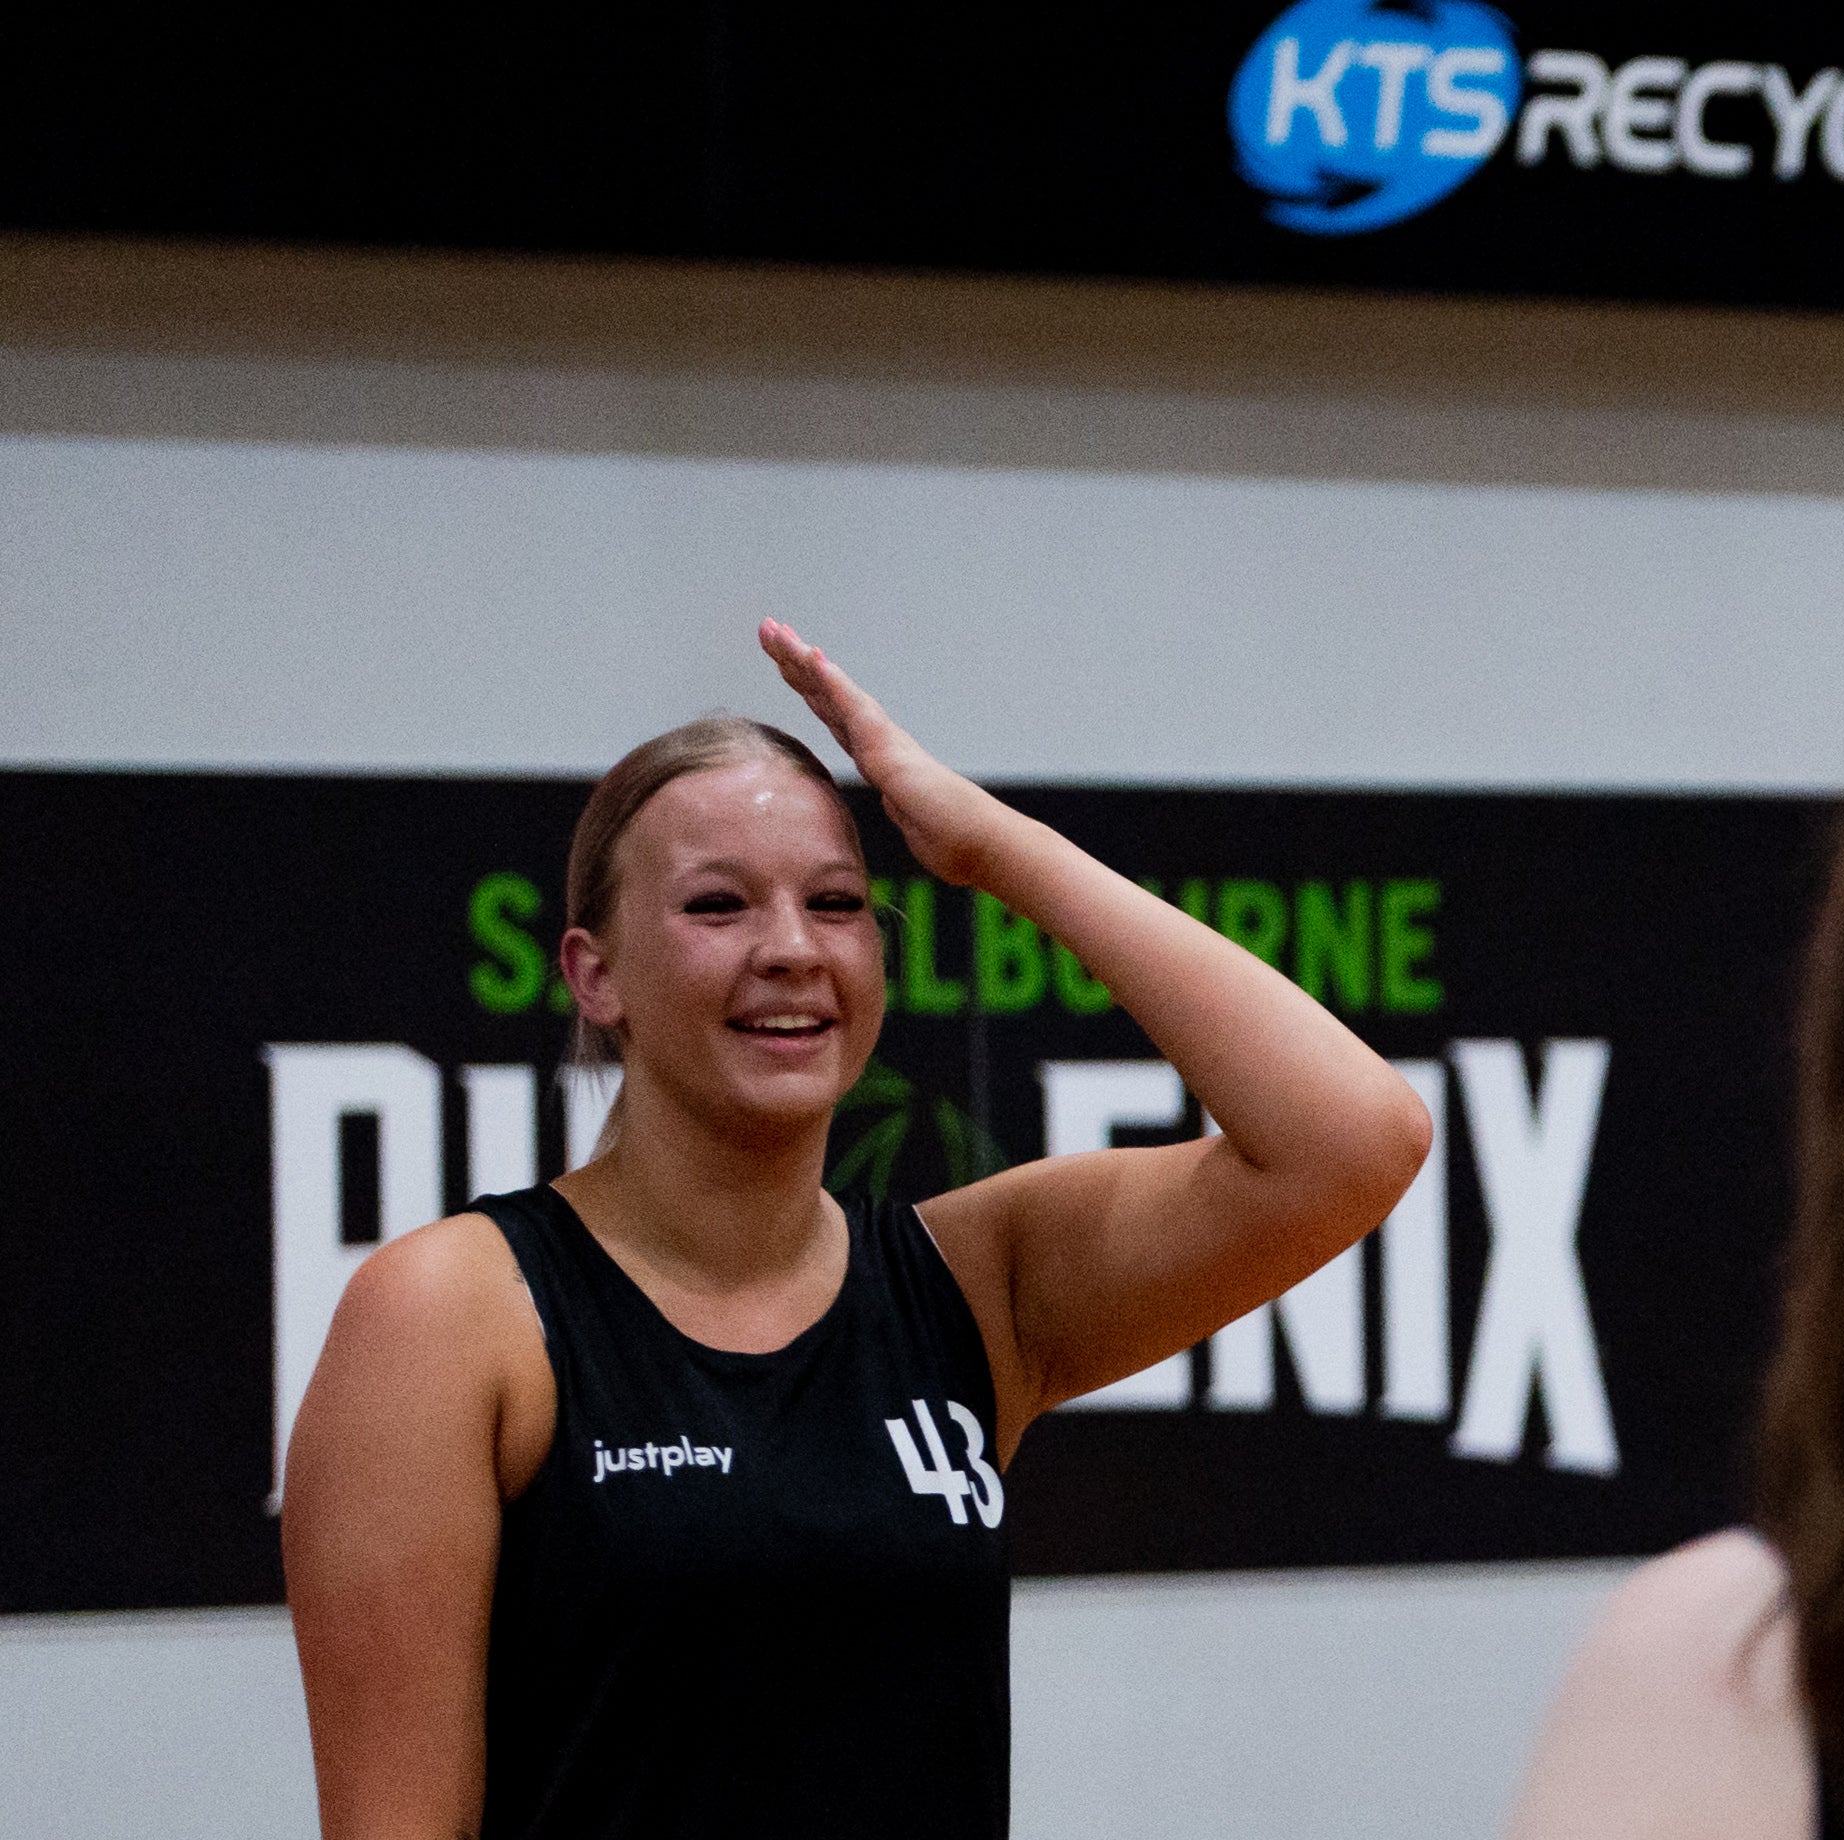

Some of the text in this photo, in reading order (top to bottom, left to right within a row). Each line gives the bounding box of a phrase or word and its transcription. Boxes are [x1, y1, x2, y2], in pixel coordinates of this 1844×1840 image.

[1264, 36, 1506, 157] KTS
[594, 1436, 733, 1482] justplay
[885, 1399, 1004, 1529] 43
